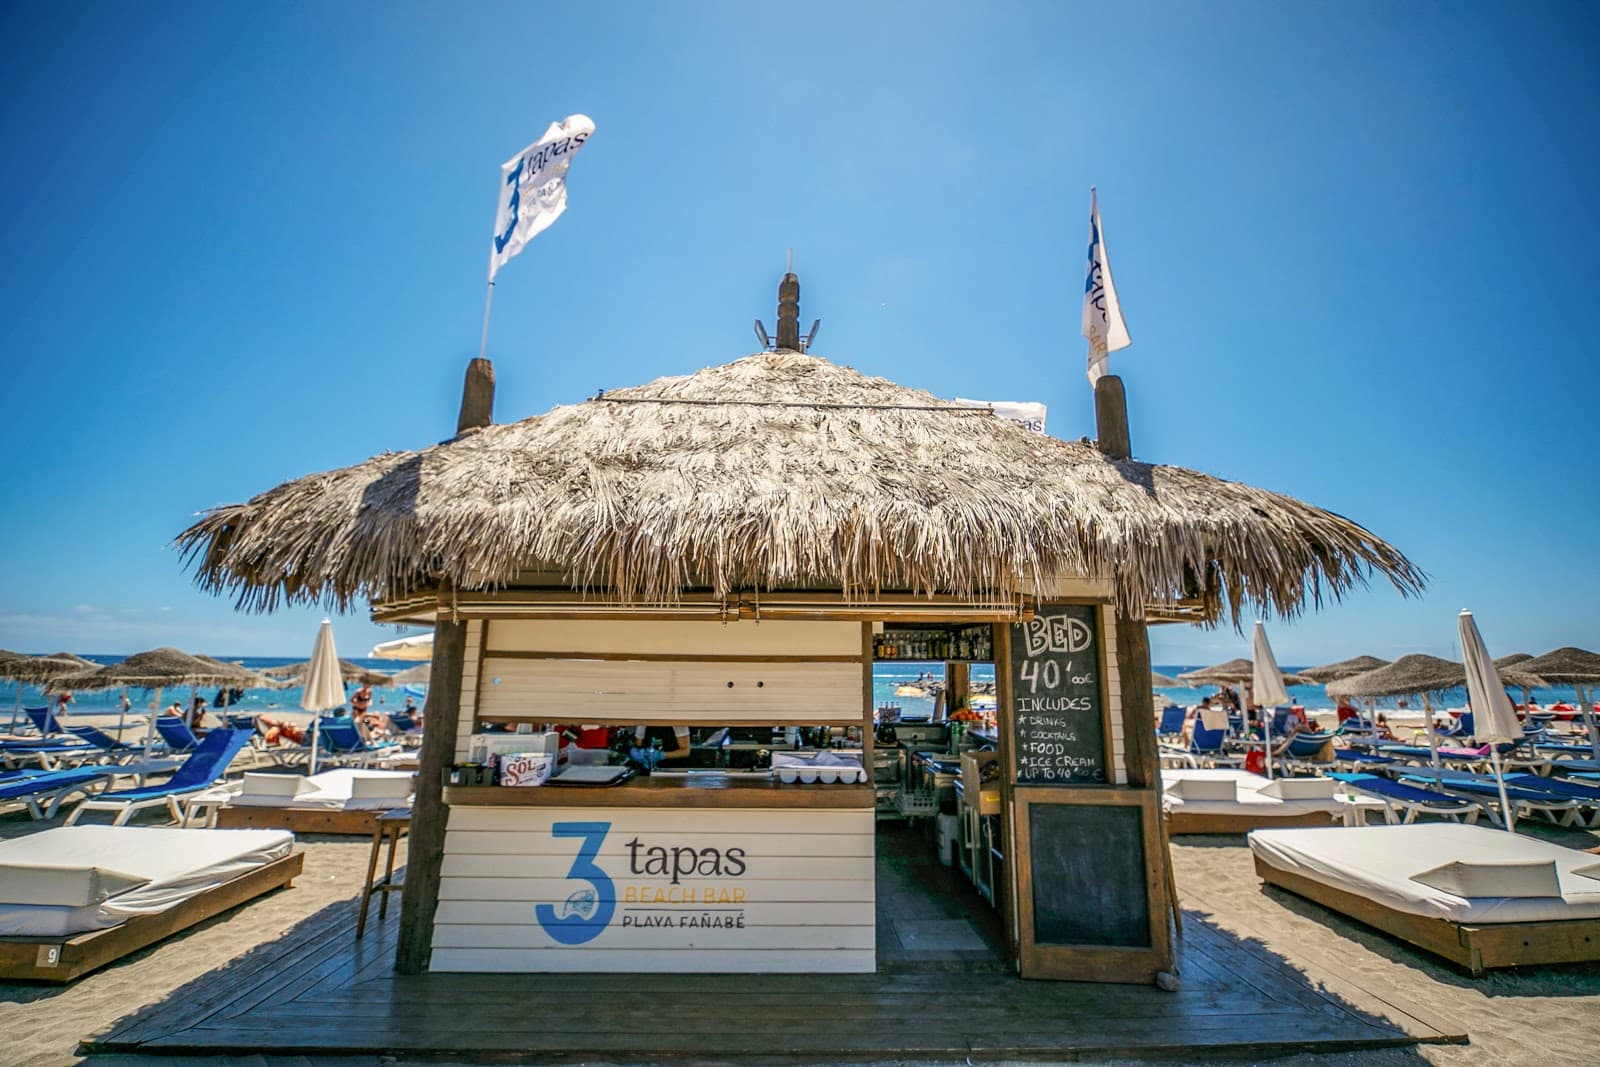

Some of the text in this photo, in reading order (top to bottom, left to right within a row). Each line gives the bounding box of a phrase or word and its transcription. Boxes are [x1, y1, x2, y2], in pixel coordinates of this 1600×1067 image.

[1023, 614, 1091, 657] BED
[1017, 697, 1092, 711] INCLUDES
[1029, 716, 1066, 727] DRINKS
[1030, 730, 1077, 741] COCKTAILS
[1029, 742, 1064, 755] FOOD
[1029, 755, 1095, 767] ICE CREAM
[1025, 768, 1039, 779] UP
[1042, 767, 1055, 779] TO
[535, 822, 746, 945] 3 tapas
[624, 886, 746, 904] BEACH BAR
[622, 912, 745, 929] PLAYA FAÑABÉ
[47, 948, 57, 963] 9
